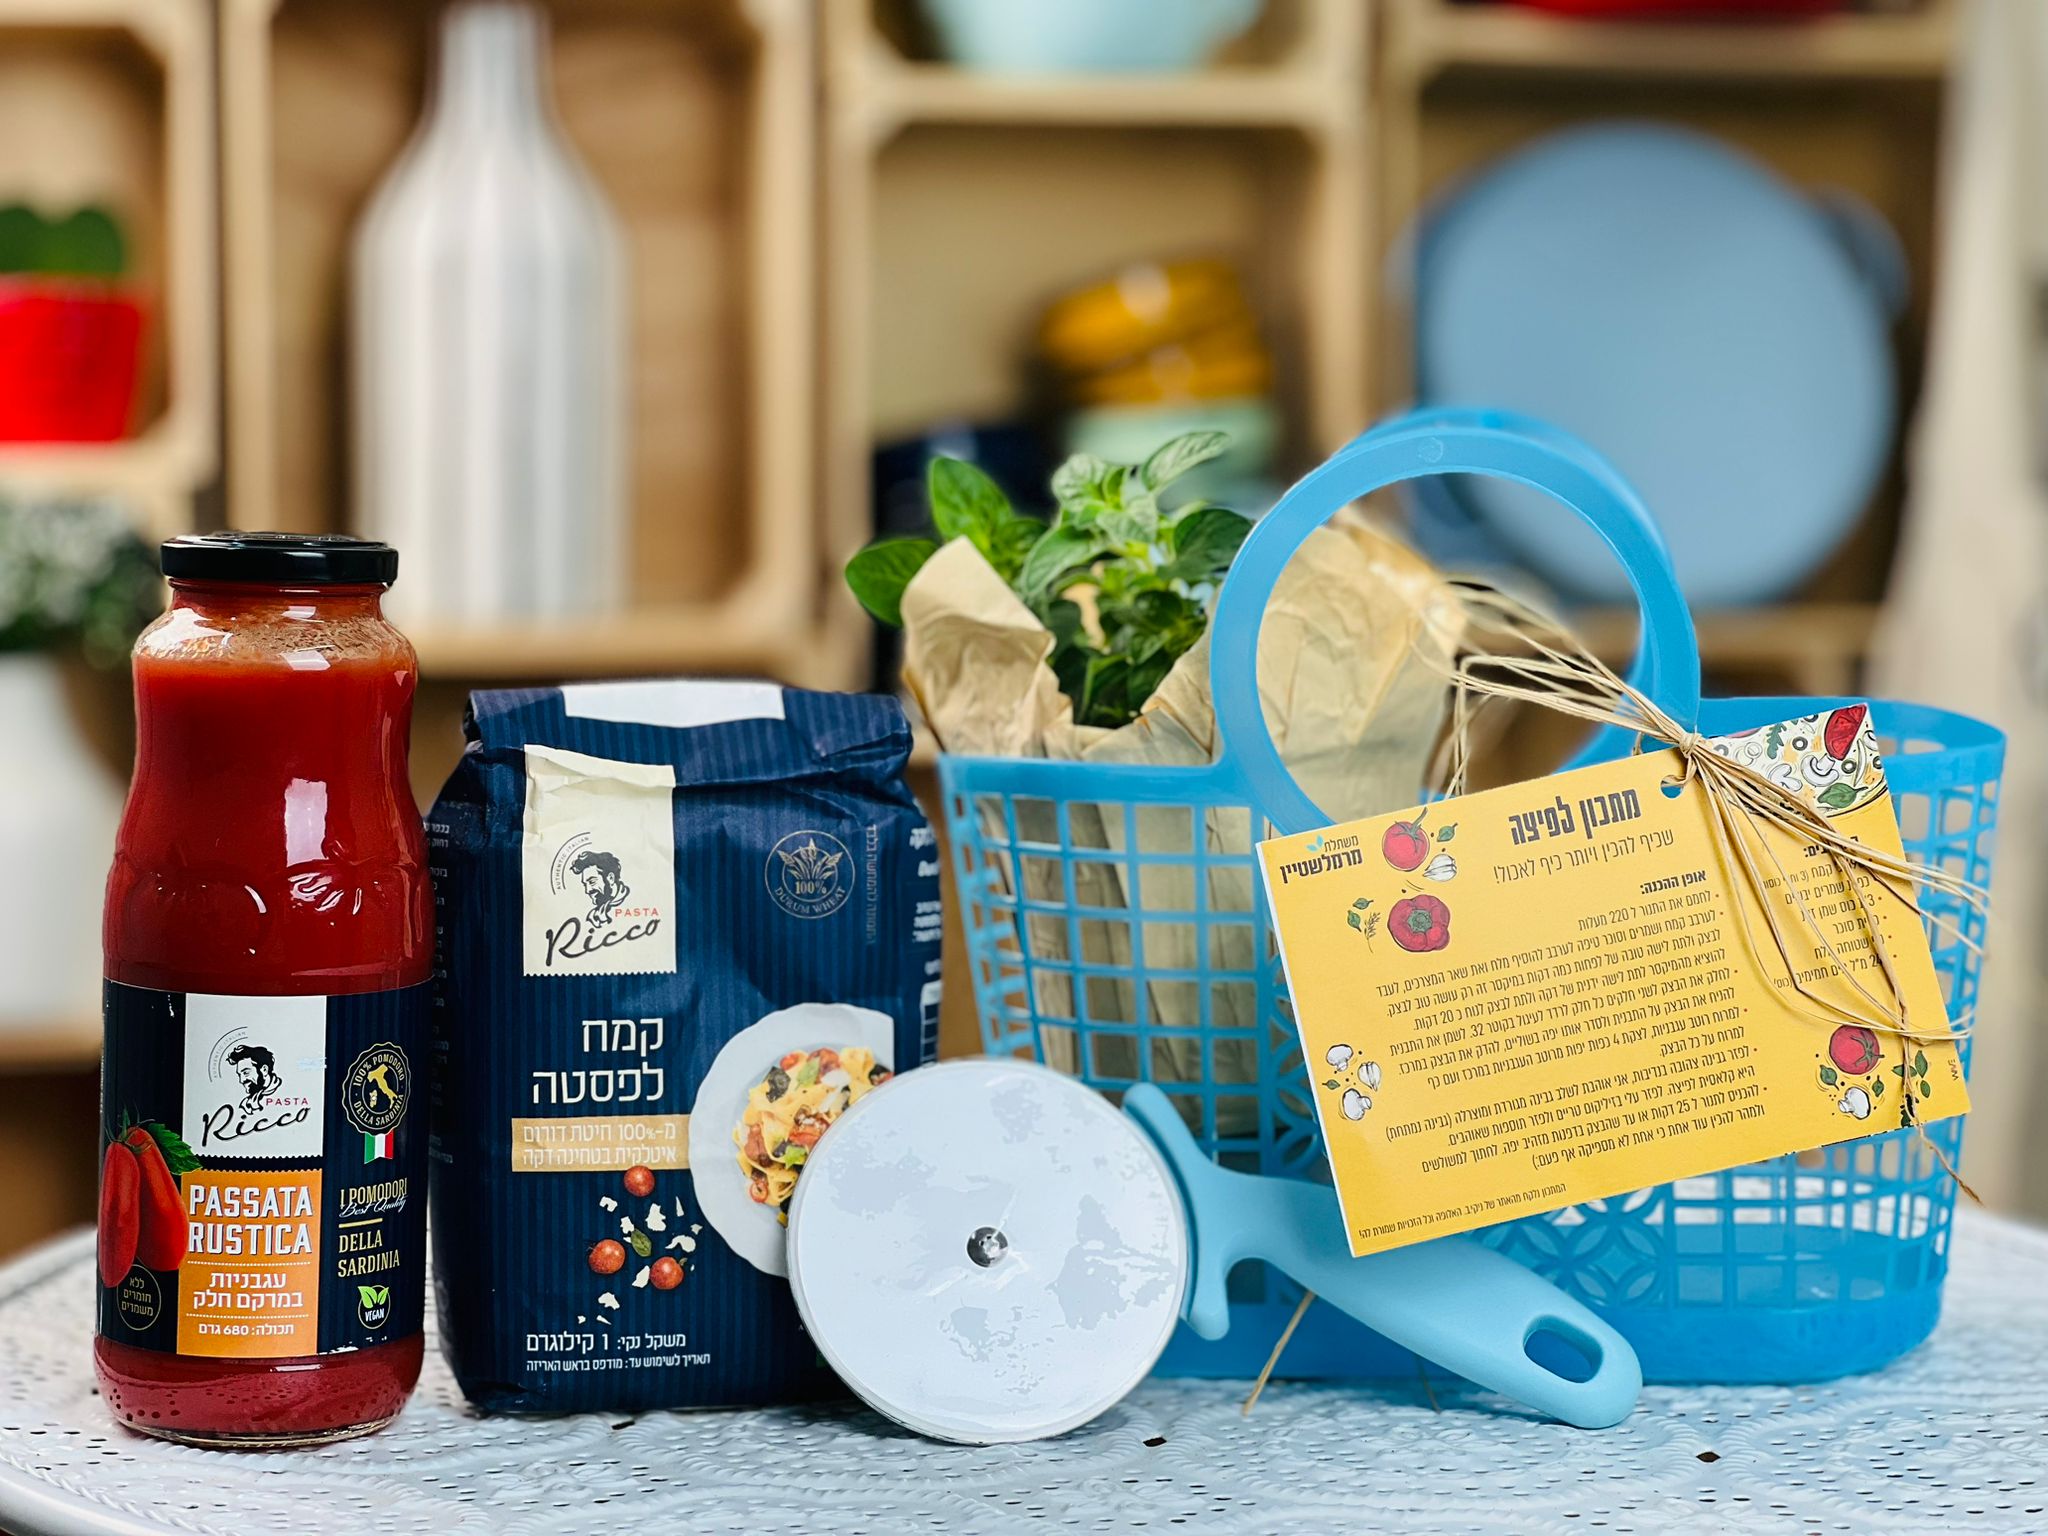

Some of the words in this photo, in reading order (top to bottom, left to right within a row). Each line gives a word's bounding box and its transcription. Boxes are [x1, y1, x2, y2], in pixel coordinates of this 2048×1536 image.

[1508, 795, 1575, 845] לפיצה
[1578, 788, 1641, 839] מתכון
[1324, 835, 1359, 853] משתלת
[1601, 835, 1634, 862] להכין
[1639, 829, 1673, 852] שכיף
[1565, 846, 1598, 866] ויותר
[1279, 848, 1363, 884] מרמלשטיין
[1493, 858, 1534, 883] לאכול!
[1539, 854, 1562, 875] כיף
[1811, 863, 1832, 877] קמח
[1639, 876, 1679, 894] ההכנה:
[1681, 870, 1706, 887] אופן
[795, 880, 827, 895] 100%
[1813, 880, 1845, 898] שמרים
[775, 887, 810, 914] DURUM
[812, 886, 846, 913] WHEAT
[1668, 897, 1683, 910] את
[1685, 890, 1710, 906] לחמם
[614, 908, 659, 917] PASTA
[1608, 907, 1629, 923] 220
[1639, 900, 1666, 915] התנור
[1818, 903, 1837, 919] שמן
[1578, 914, 1607, 931] מעלות
[1664, 916, 1685, 931] קמח
[1687, 909, 1715, 926] לערבב
[1628, 922, 1662, 939] ושמרים
[1832, 920, 1854, 934] סוכר
[545, 917, 661, 967] Ricco
[1577, 936, 1600, 951] טיפה
[1602, 930, 1626, 944] וסוכר
[1671, 935, 1695, 950] ולתת
[1697, 928, 1720, 946] לבצק
[1836, 935, 1871, 954] שטוחה
[1545, 941, 1573, 959] לערבב
[1621, 946, 1643, 961] טובה
[1646, 940, 1668, 955] לישה
[1490, 957, 1510, 971] מלח
[1511, 948, 1542, 967] להוסיף
[1573, 955, 1602, 972] לפחות
[1604, 952, 1618, 965] של
[1693, 947, 1725, 965] להוציא
[1447, 966, 1468, 980] שאר
[1470, 962, 1488, 976] ואת
[1552, 963, 1572, 977] כמה
[1626, 965, 1645, 981] לתת
[1648, 956, 1692, 975] מהמיקסר
[1489, 974, 1525, 991] במיקסר
[1526, 968, 1549, 983] דקות
[1601, 970, 1623, 986] לישה
[1375, 982, 1398, 997] לעבד
[1460, 985, 1473, 1000] רק
[1475, 982, 1487, 994] זה
[1559, 983, 1574, 995] של
[1575, 977, 1598, 992] ידנית
[1414, 995, 1430, 1009] טוב
[1433, 989, 1458, 1005] עושה
[1513, 991, 1536, 1007] ולתת
[1538, 986, 1558, 1002] דקה
[1464, 1003, 1483, 1018] לנוח
[1486, 996, 1510, 1015] לבצק
[1439, 1009, 1454, 1024] 20
[582, 1018, 664, 1057] קמח
[1701, 1051, 1726, 1066] גבינה
[1727, 1045, 1749, 1060] לפזר
[353, 1062, 372, 1087] 100%
[372, 1054, 405, 1081] POMODORO
[1669, 1057, 1699, 1074] צהובה
[1737, 1065, 1755, 1079] היא
[532, 1061, 664, 1104] לפסטה
[1581, 1077, 1612, 1094] אוהבת
[1613, 1073, 1628, 1086] אני
[1698, 1069, 1735, 1088] קלאסית
[1529, 1090, 1554, 1106] גבינה
[1555, 1083, 1578, 1100] לשלב
[1623, 1091, 1639, 1104] עלי
[1641, 1085, 1662, 1100] לפזר
[266, 1097, 309, 1106] PASTA
[1493, 1096, 1527, 1114] מגורדת
[1583, 1095, 1622, 1114] בזיליקום
[354, 1100, 373, 1125] DELLA
[375, 1094, 404, 1126] SARDINIA
[1454, 1105, 1492, 1123] ומוצרלה
[1555, 1104, 1581, 1120] טריים
[1735, 1104, 1765, 1120] ולמהר
[201, 1104, 311, 1147] Ricco
[1423, 1112, 1452, 1130] (גבינה
[1491, 1117, 1527, 1135] תוספות
[1528, 1111, 1554, 1126] ולפזר
[1691, 1117, 1708, 1130] עוד
[1710, 1110, 1733, 1128] להכין
[523, 1125, 566, 1143] דורום
[569, 1124, 612, 1141] חיטת
[1385, 1121, 1422, 1142] נמתחת)
[1632, 1129, 1654, 1144] אחת
[1656, 1126, 1665, 1138] כי
[1667, 1121, 1689, 1136] אחת
[1577, 1138, 1615, 1157] מספיקה
[1617, 1134, 1629, 1148] לא
[523, 1149, 553, 1169] דקה
[557, 1148, 611, 1165] בטחינה
[615, 1143, 677, 1166] איטלקית
[1560, 1147, 1576, 1162] אף
[349, 1177, 408, 1205] POMODORI
[189, 1184, 314, 1218] PASSATA
[339, 1201, 374, 1218] Best
[373, 1194, 409, 1213] Quality
[188, 1221, 313, 1255] RUSTICA
[338, 1229, 383, 1253] DELLA
[337, 1249, 400, 1278] SARDINIA
[129, 1276, 145, 1289] ללא
[209, 1272, 286, 1289] עגבניות
[123, 1288, 152, 1304] חומרים
[193, 1290, 231, 1310] חלק
[237, 1292, 303, 1312] במרקם
[121, 1301, 154, 1317] משמרים
[365, 1308, 385, 1322] VEGAN
[199, 1324, 221, 1335] גרם
[224, 1325, 249, 1336] 680
[251, 1323, 294, 1336] תכולה:
[526, 1330, 594, 1355] קילוגרם
[602, 1333, 609, 1350] 1
[616, 1335, 641, 1352] נקי:
[646, 1333, 686, 1350] משקל
[526, 1360, 561, 1373] האריזה
[562, 1360, 591, 1371] בראש
[592, 1358, 623, 1371] מודפס
[624, 1357, 642, 1369] עד:
[643, 1354, 680, 1368] לשימוש
[683, 1353, 711, 1367] תאריך
